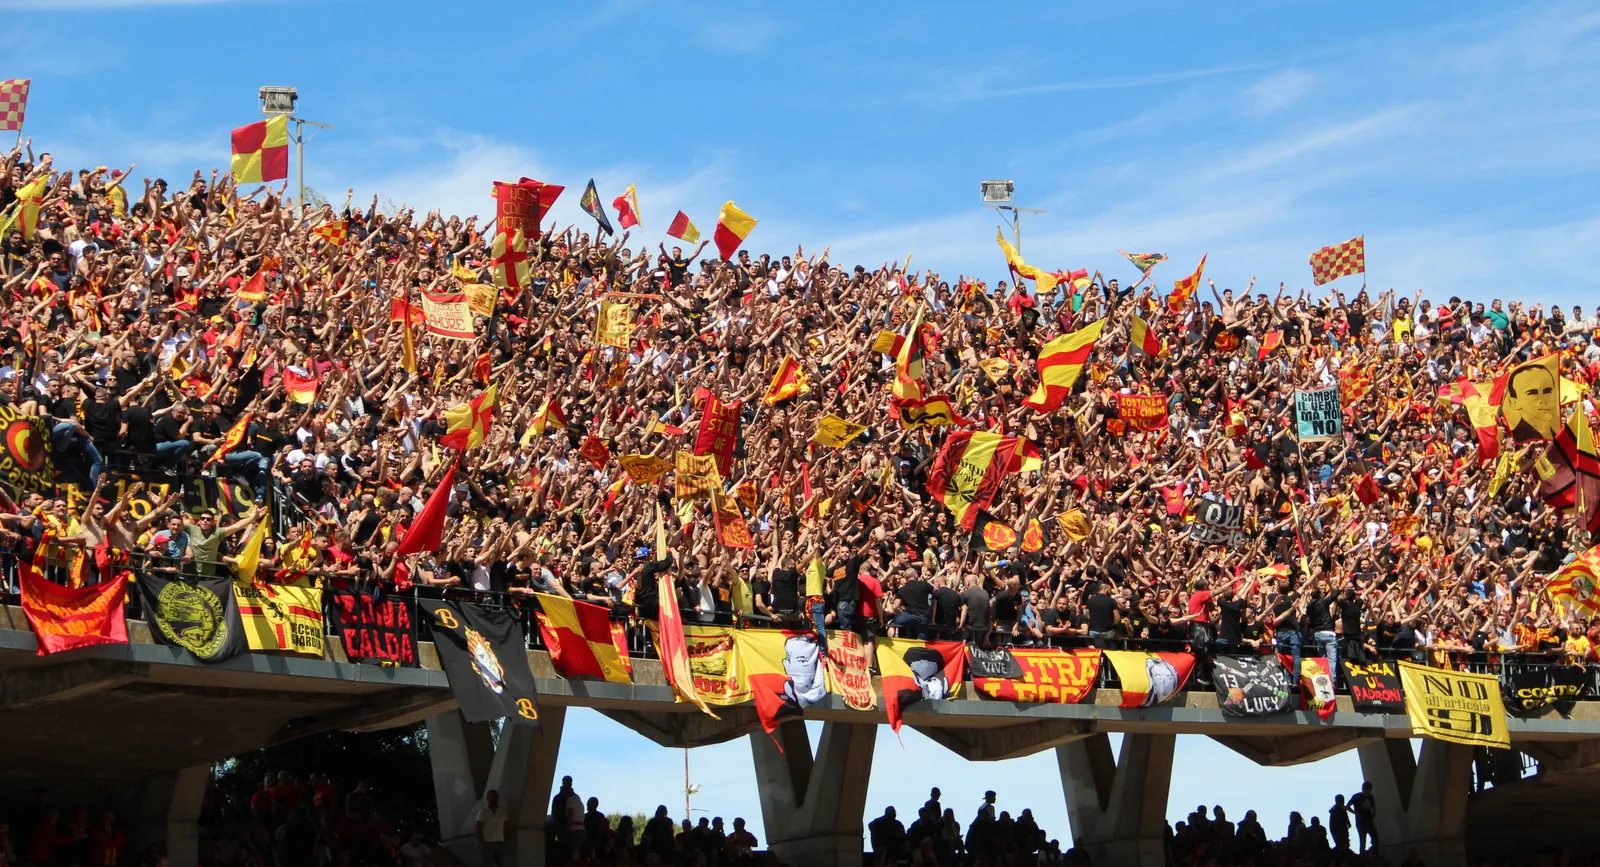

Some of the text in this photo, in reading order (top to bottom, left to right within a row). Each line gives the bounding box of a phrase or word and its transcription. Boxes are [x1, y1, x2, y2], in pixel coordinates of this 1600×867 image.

[430, 314, 466, 331] AMORE
[1297, 401, 1308, 411] IL
[1301, 410, 1340, 421] MA NOI
[708, 418, 735, 436] STATE
[1312, 420, 1337, 435] NO
[714, 437, 726, 450] OF
[1205, 503, 1242, 529] Old
[235, 587, 264, 598] LECCE
[334, 594, 411, 629] ZONA
[343, 628, 414, 664] CALDA
[982, 661, 1008, 674] VIVE
[1344, 661, 1395, 677] SENZA
[1219, 672, 1288, 688] 13 12
[1420, 674, 1488, 701] NO
[1352, 685, 1402, 702] PADRONI
[1243, 696, 1280, 713] LUCY
[1425, 696, 1490, 712] all'articolo
